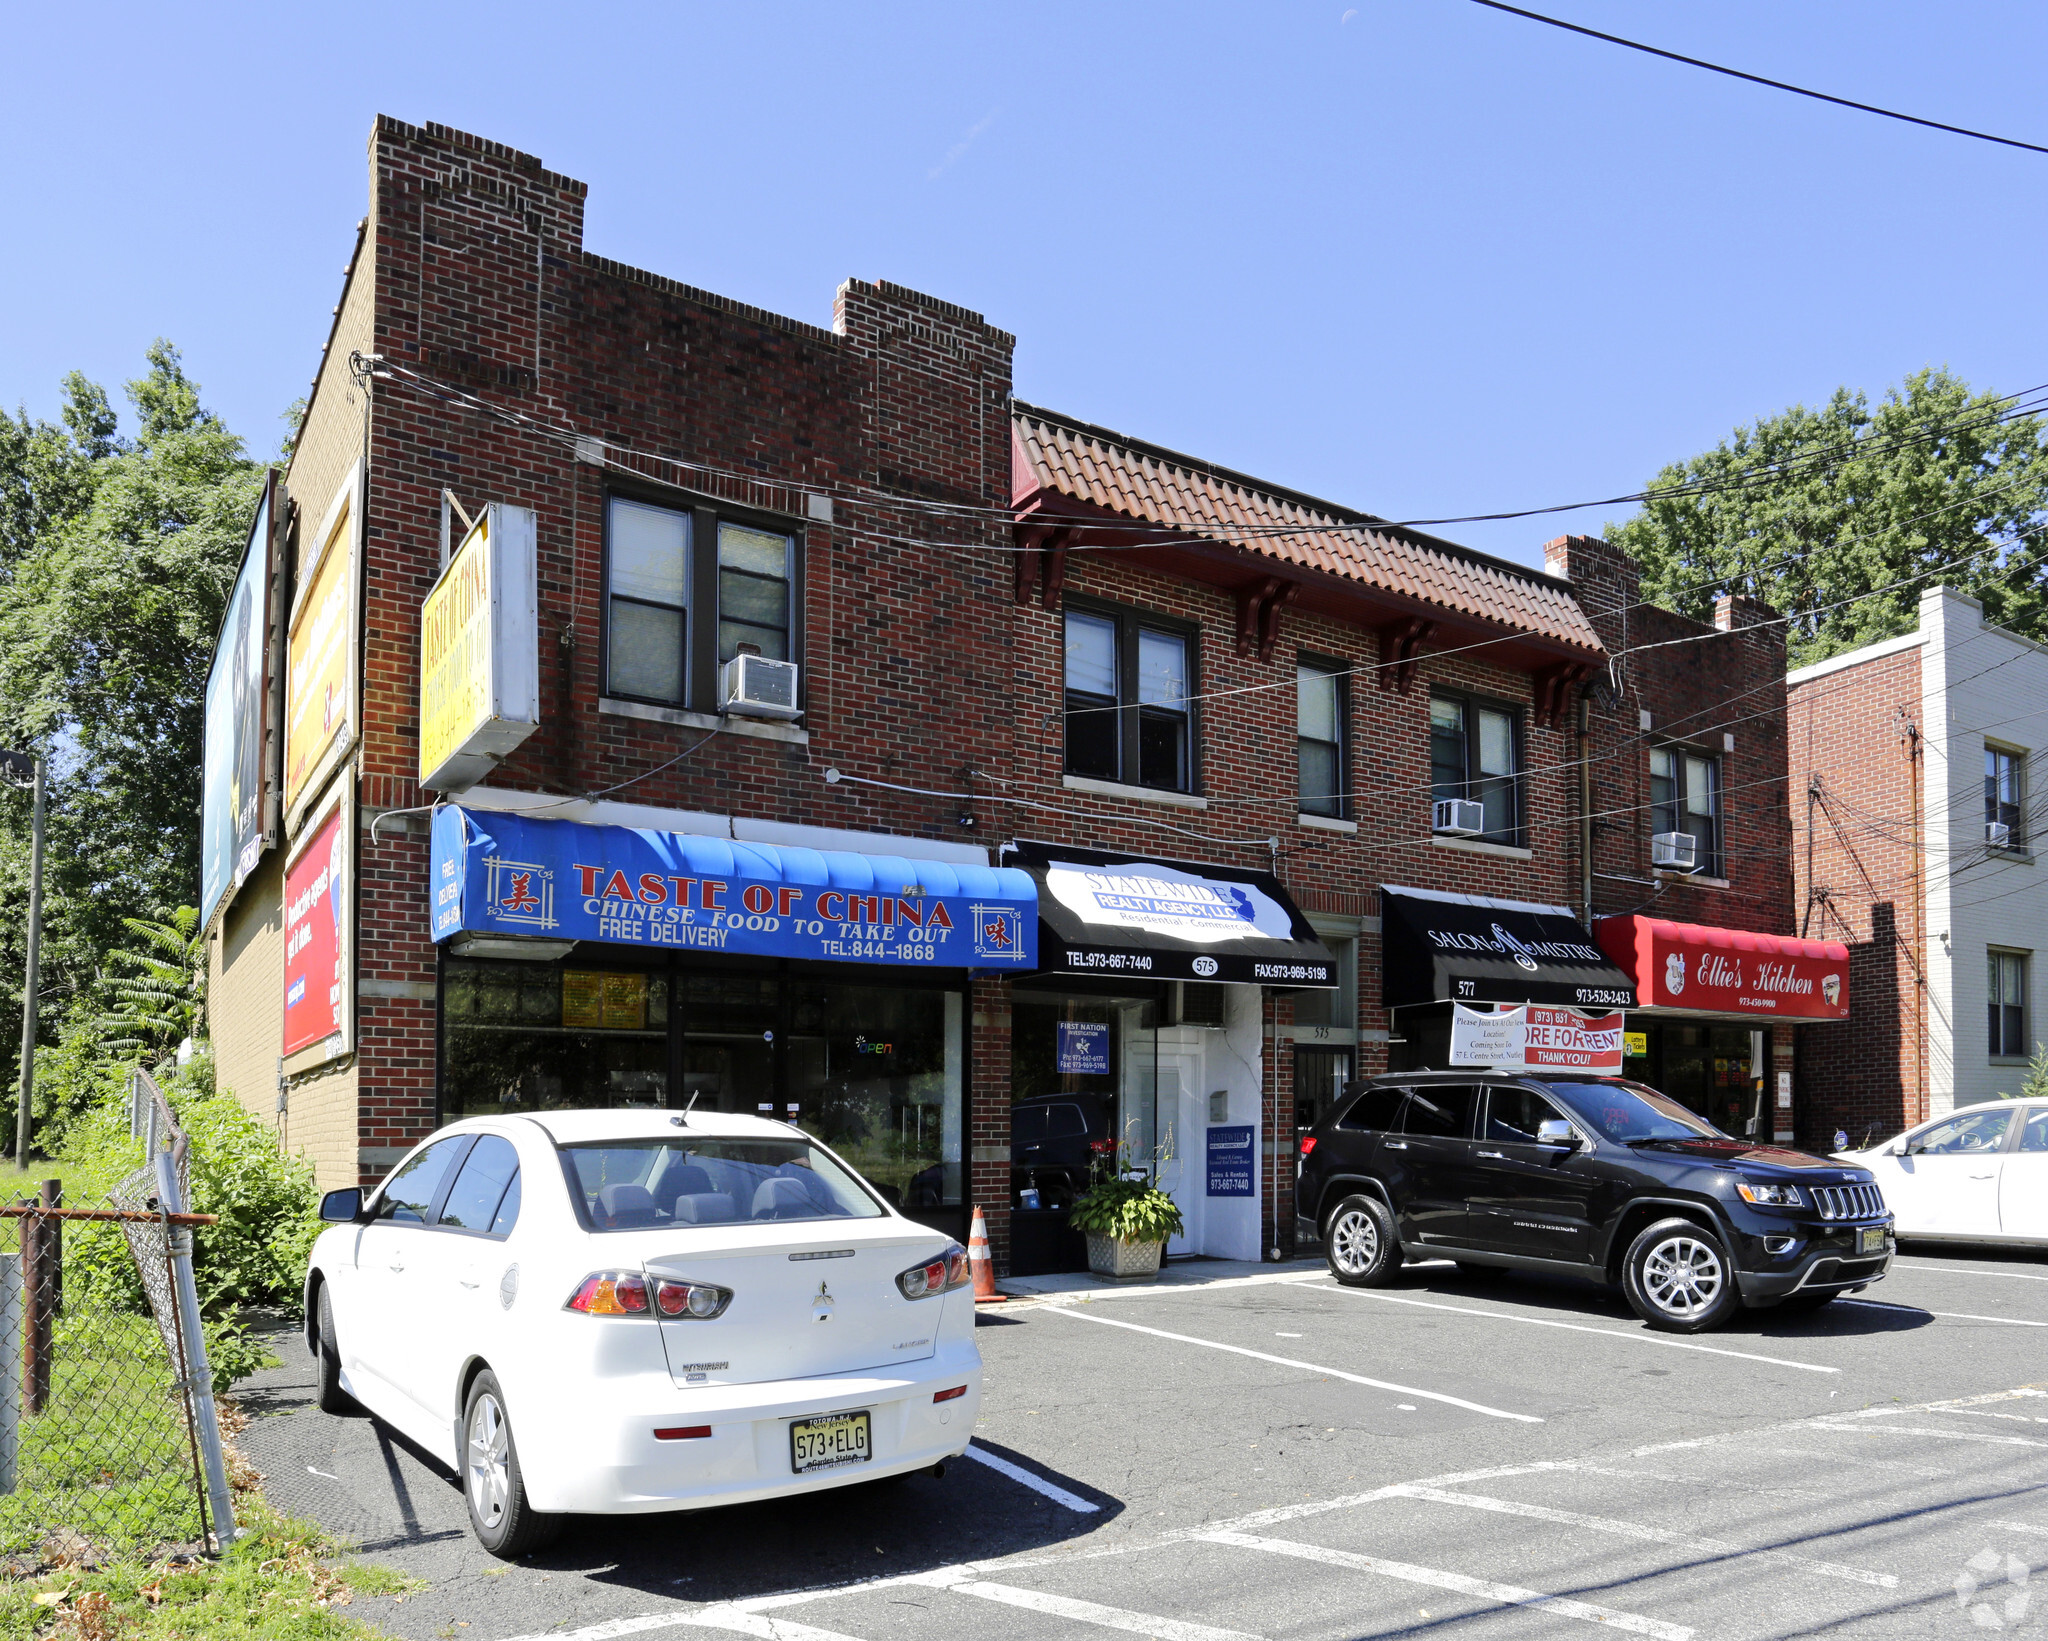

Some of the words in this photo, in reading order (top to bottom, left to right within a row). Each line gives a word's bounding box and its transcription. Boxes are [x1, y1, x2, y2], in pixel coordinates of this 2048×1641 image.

[425, 593, 448, 674] TASTE
[449, 576, 458, 645] OF
[459, 548, 487, 629] CHINA
[442, 858, 455, 879] FREE
[500, 872, 541, 913] 美
[572, 863, 729, 911] TASTE
[742, 884, 803, 917] OF
[815, 891, 955, 930] CHINA
[1084, 872, 1234, 904] STATEWIDE
[1097, 894, 1151, 911] REALTY
[1153, 899, 1212, 918] AGENCY,
[1212, 904, 1237, 920] LLC
[583, 899, 696, 926] CHINESE
[711, 911, 780, 932] FOOD
[793, 918, 824, 936] TO
[838, 923, 895, 941] TAKE
[908, 927, 952, 943] OUT
[1120, 912, 1183, 926] Residential
[1190, 918, 1253, 932] Commercial
[599, 917, 643, 941] FREE
[650, 922, 729, 948] DELIVERY
[984, 914, 1013, 949] 味
[821, 939, 935, 961] TEL:844-1868
[1427, 930, 1494, 951] SALON
[1529, 941, 1601, 961] MISTRIS
[1066, 951, 1152, 970] TEL:973-667-7440
[1195, 959, 1215, 973] 575
[1254, 963, 1327, 981] FAX:973-969-5198
[1697, 952, 1743, 989] Ellie's
[1752, 961, 1813, 995] Kitchen
[1458, 981, 1475, 997] 577
[1576, 988, 1631, 1005] 973-528-2423
[1738, 997, 1776, 1009] 973-450-9900
[1060, 1022, 1079, 1030] FIRST
[1080, 1023, 1106, 1031] NATION
[1456, 1017, 1477, 1026] Please
[1478, 1018, 1490, 1027] Join
[1535, 1010, 1553, 1026] (973)
[1314, 1026, 1329, 1039] 575
[1554, 1028, 1585, 1048] FOR
[1584, 1031, 1620, 1050] RENT
[1631, 1036, 1644, 1044] Lottery
[1470, 1040, 1493, 1050] Coming
[1456, 1051, 1462, 1059] 57
[1469, 1051, 1489, 1059] Centre
[1506, 1051, 1524, 1060] Nutley
[1538, 1051, 1565, 1064] THANK
[1565, 1052, 1591, 1065] YOU!
[1602, 1107, 1629, 1124] OPEN
[1210, 1132, 1245, 1142] STATEWIDE
[828, 1420, 849, 1429] Jersey
[796, 1432, 826, 1459] S73
[836, 1426, 864, 1453] ELG
[812, 1457, 834, 1465] Garden
